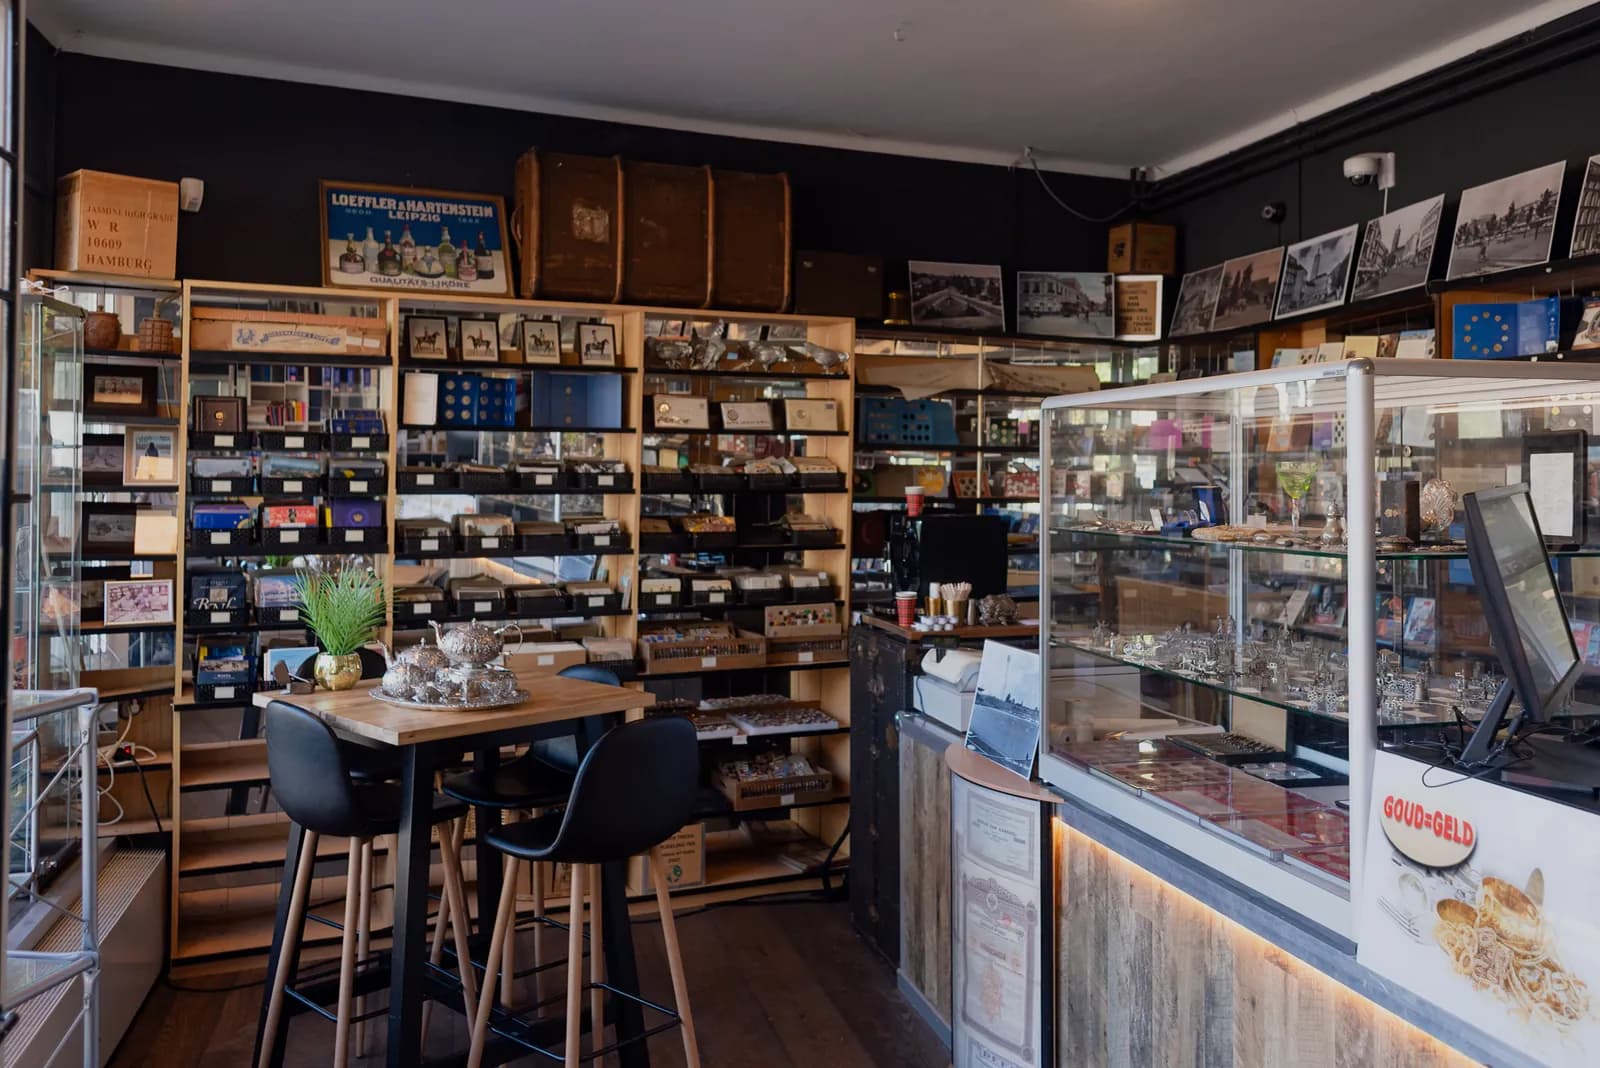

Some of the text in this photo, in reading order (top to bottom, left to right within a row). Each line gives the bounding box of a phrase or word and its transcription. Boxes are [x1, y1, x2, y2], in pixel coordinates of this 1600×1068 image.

[388, 210, 441, 223] LEIPZIG
[87, 219, 119, 233] W R
[87, 236, 122, 249] 10609
[86, 253, 152, 271] HAMBURG
[1384, 795, 1474, 847] GOUD=GELD
